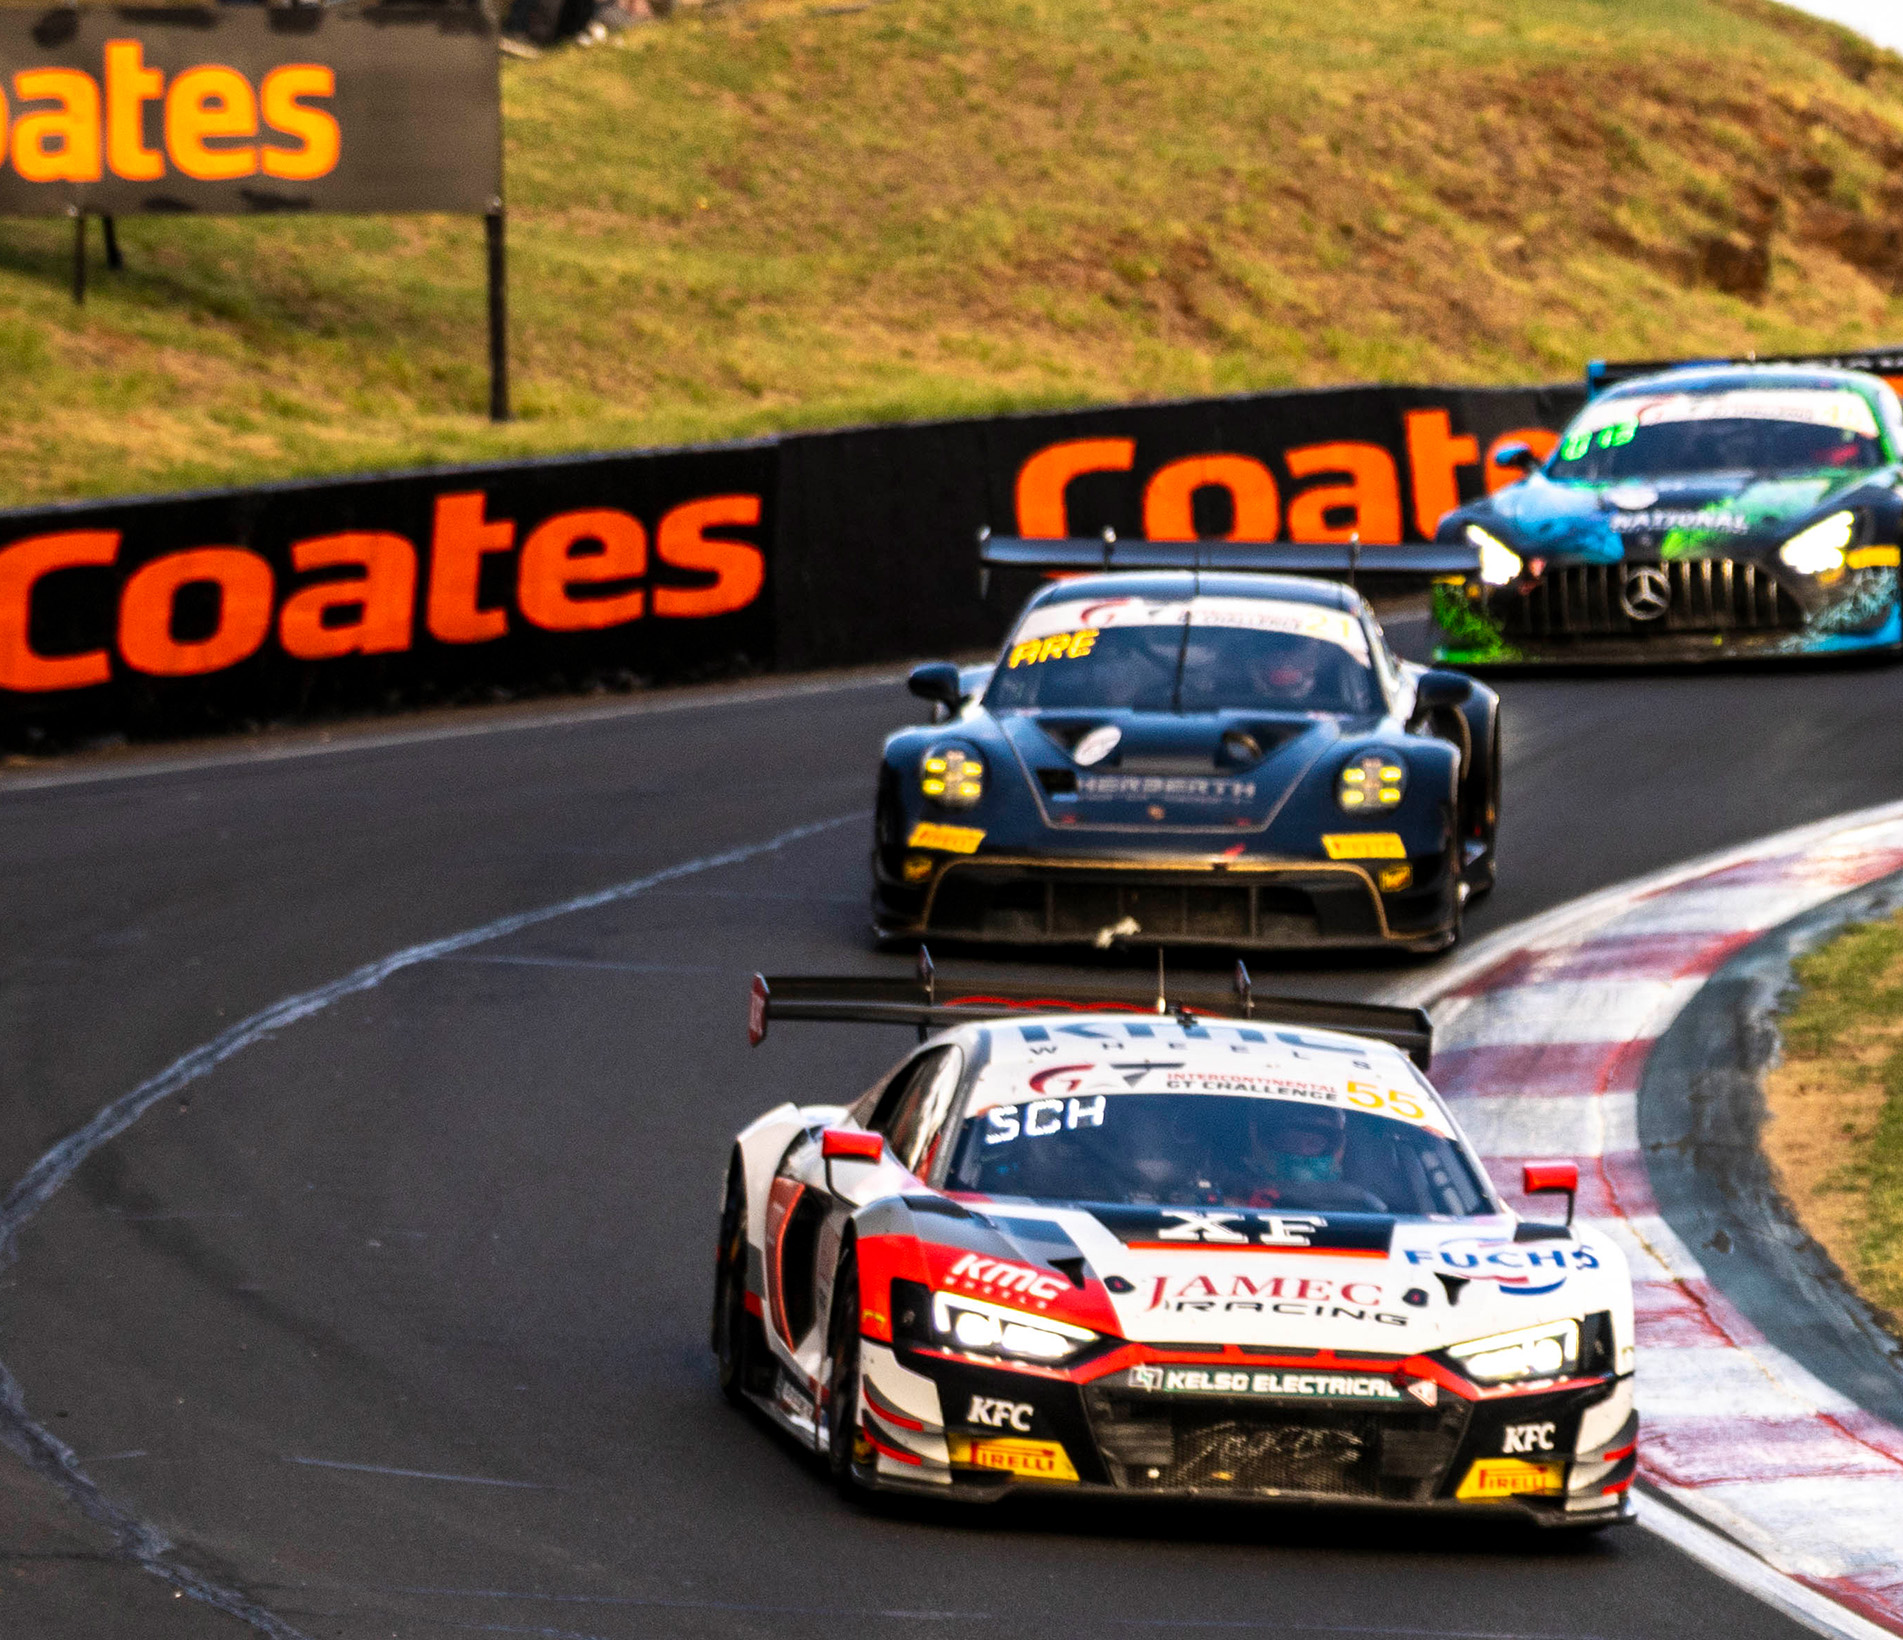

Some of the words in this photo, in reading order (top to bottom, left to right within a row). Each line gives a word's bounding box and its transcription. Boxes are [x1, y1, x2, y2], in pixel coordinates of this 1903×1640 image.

[0, 38, 342, 183] ates
[0, 490, 766, 693] Coates
[1009, 629, 1099, 669] ARE
[1166, 1080, 1194, 1089] GT
[1202, 1080, 1339, 1101] CHALLENGE
[1167, 1073, 1338, 1094] INTERCONTINENTAL
[1347, 1080, 1426, 1120] 55
[984, 1096, 1107, 1146] SCH
[1403, 1243, 1600, 1271] FUCHS
[1144, 1274, 1384, 1311] JAMEC
[1172, 1300, 1410, 1327] RACING
[1167, 1370, 1249, 1393] KELSO
[1252, 1373, 1400, 1398] ELECTRICAL
[966, 1395, 1034, 1433] KFC
[1504, 1421, 1556, 1454] KFC
[969, 1440, 1056, 1472] PIRELLI
[1478, 1464, 1549, 1491] PIRELLI
